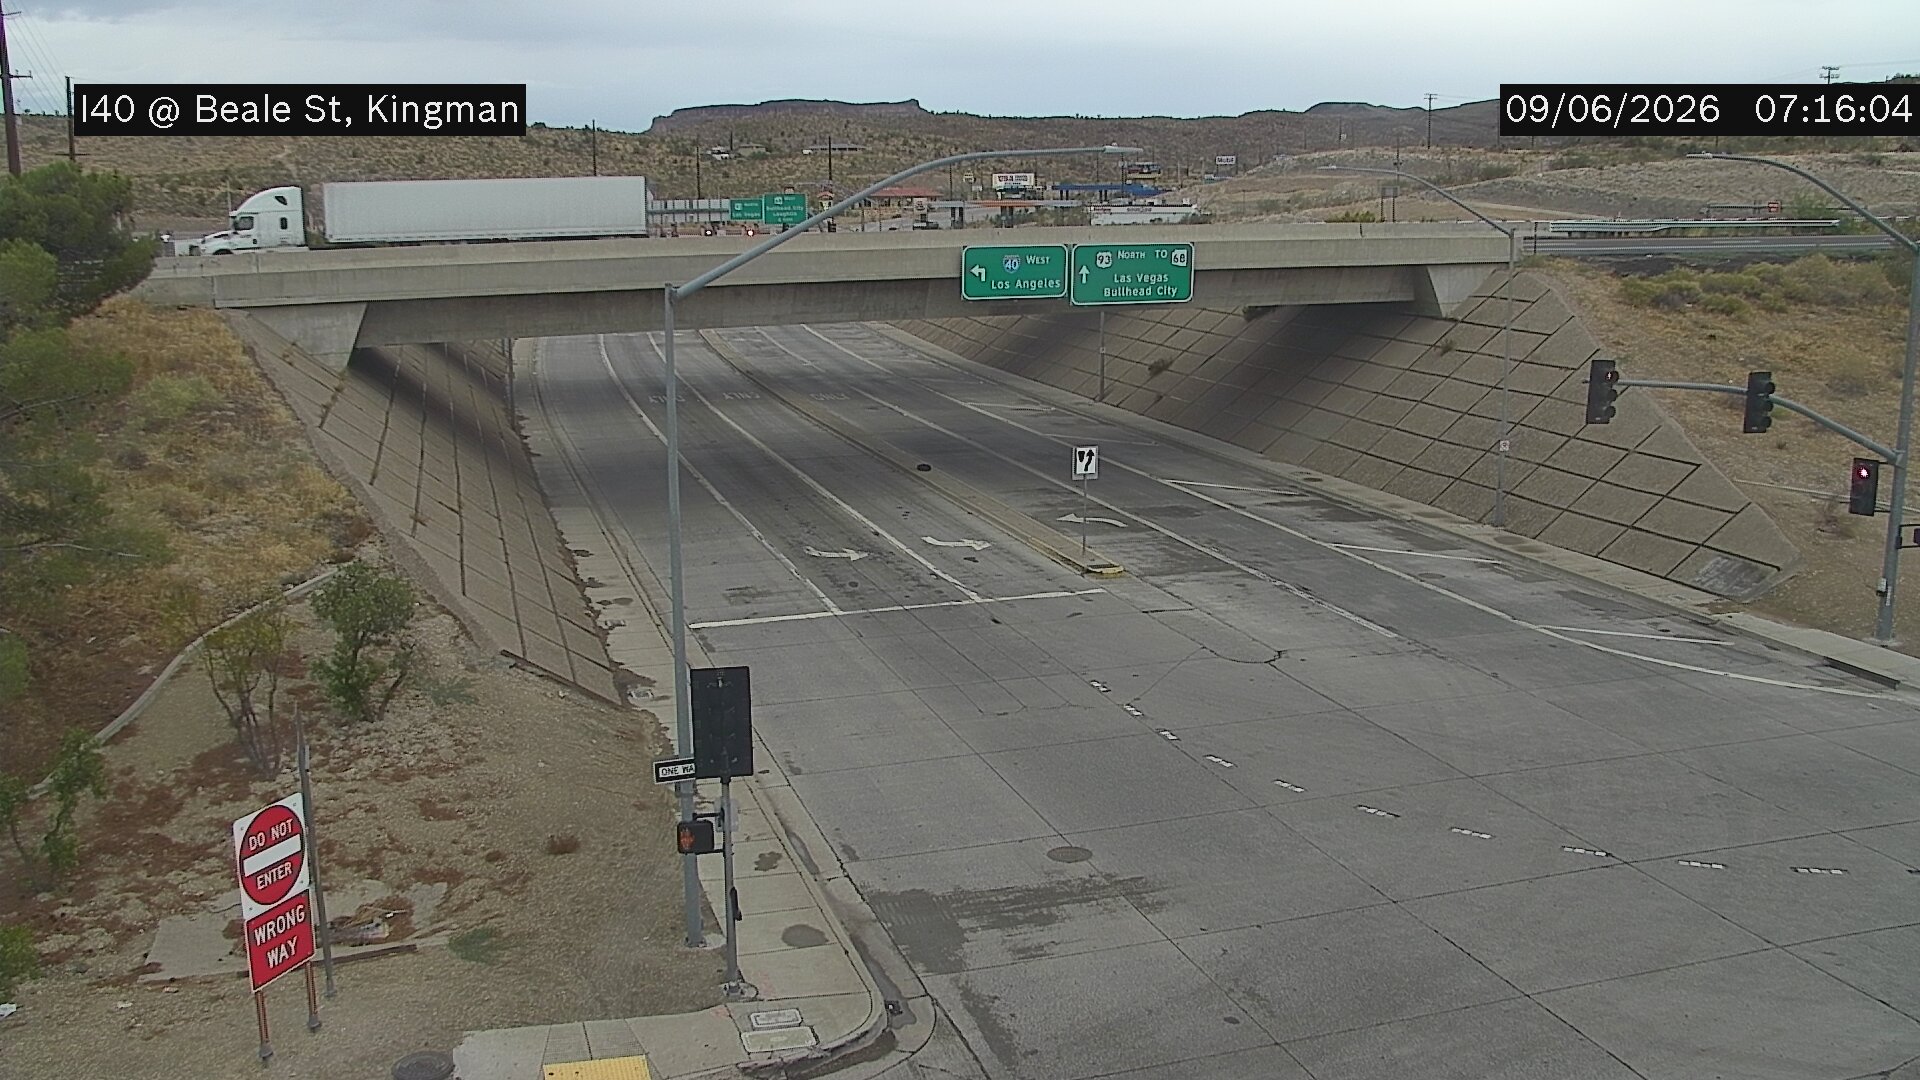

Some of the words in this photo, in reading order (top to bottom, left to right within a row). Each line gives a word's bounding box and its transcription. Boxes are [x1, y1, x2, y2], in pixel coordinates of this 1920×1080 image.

[1097, 255, 1110, 265] 93
[1155, 249, 1168, 259] TO
[1173, 253, 1186, 264] 68
[1005, 259, 1019, 270] 40
[991, 280, 1010, 290] Los
[1015, 278, 1061, 291] Angeles
[1114, 273, 1132, 283] Las
[1136, 273, 1169, 285] Vegas
[1104, 286, 1152, 297] Bullhead
[1156, 285, 1178, 298] City
[661, 766, 679, 776] ONE
[682, 764, 695, 775] WA
[248, 831, 265, 851] DO
[271, 818, 293, 842] NOT
[256, 861, 293, 890] ENTER
[254, 904, 306, 947] WRONG
[266, 935, 298, 969] WAY
